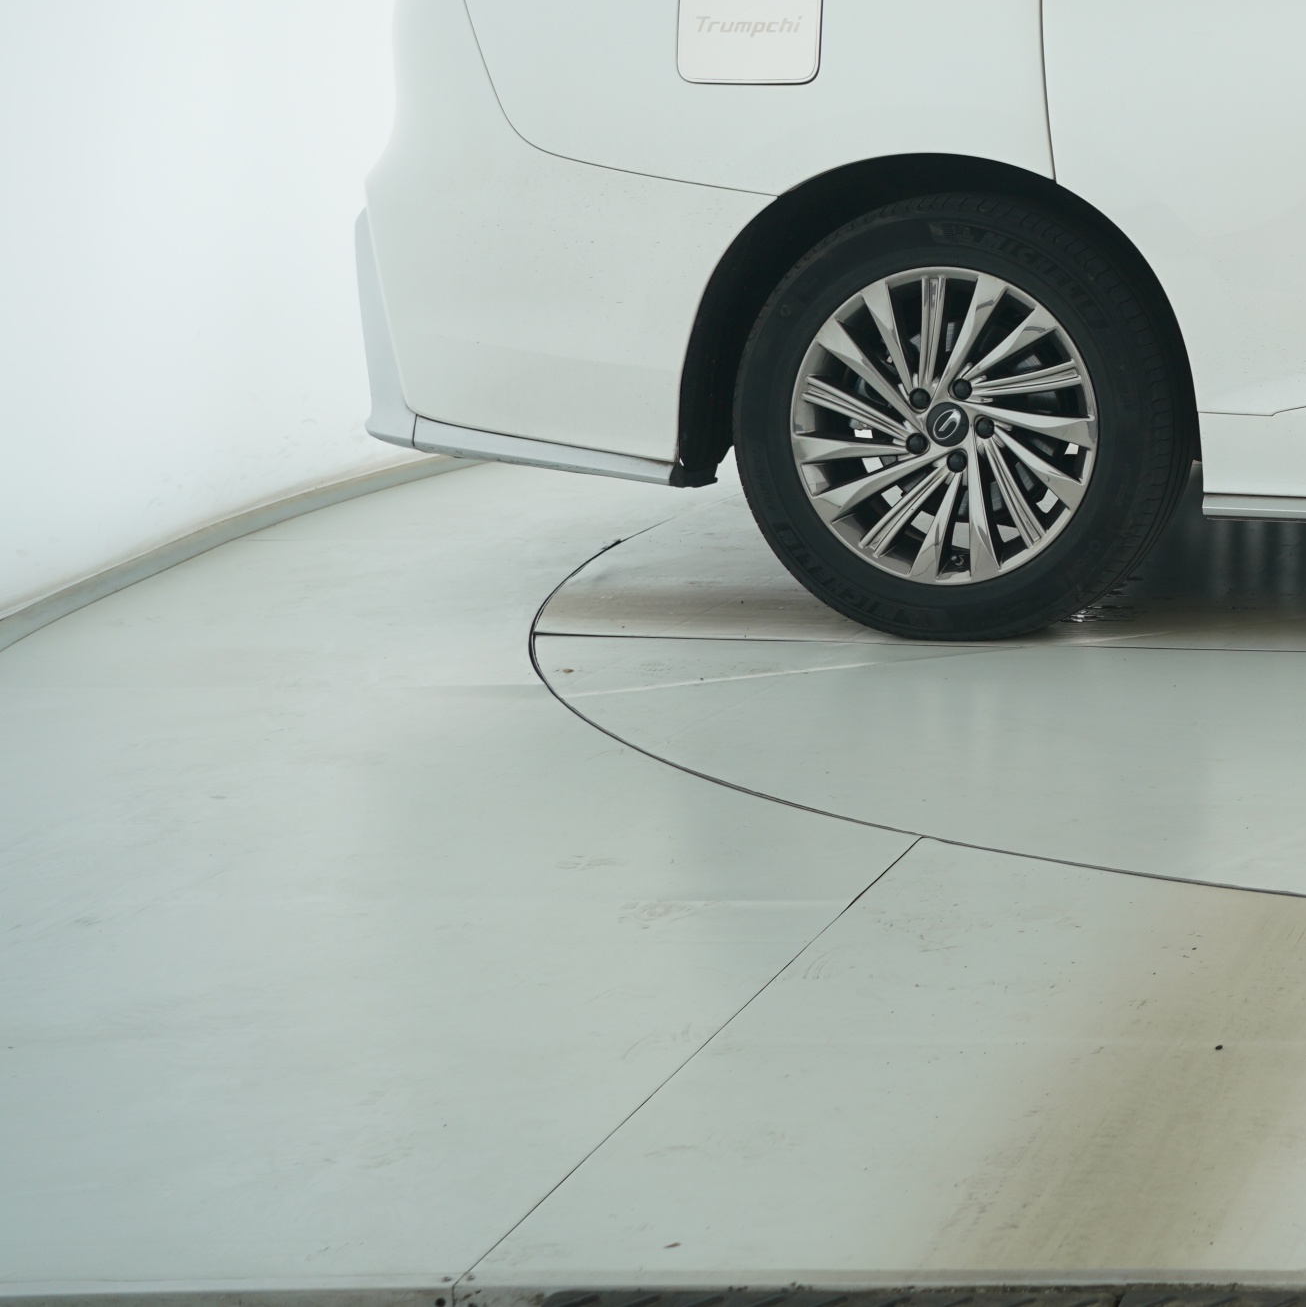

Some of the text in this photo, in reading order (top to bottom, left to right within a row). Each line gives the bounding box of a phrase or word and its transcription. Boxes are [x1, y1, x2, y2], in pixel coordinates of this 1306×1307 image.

[696, 16, 803, 38] Trumpchi
[981, 230, 1107, 329] MICHELIN
[776, 525, 900, 621] MICHELIN
